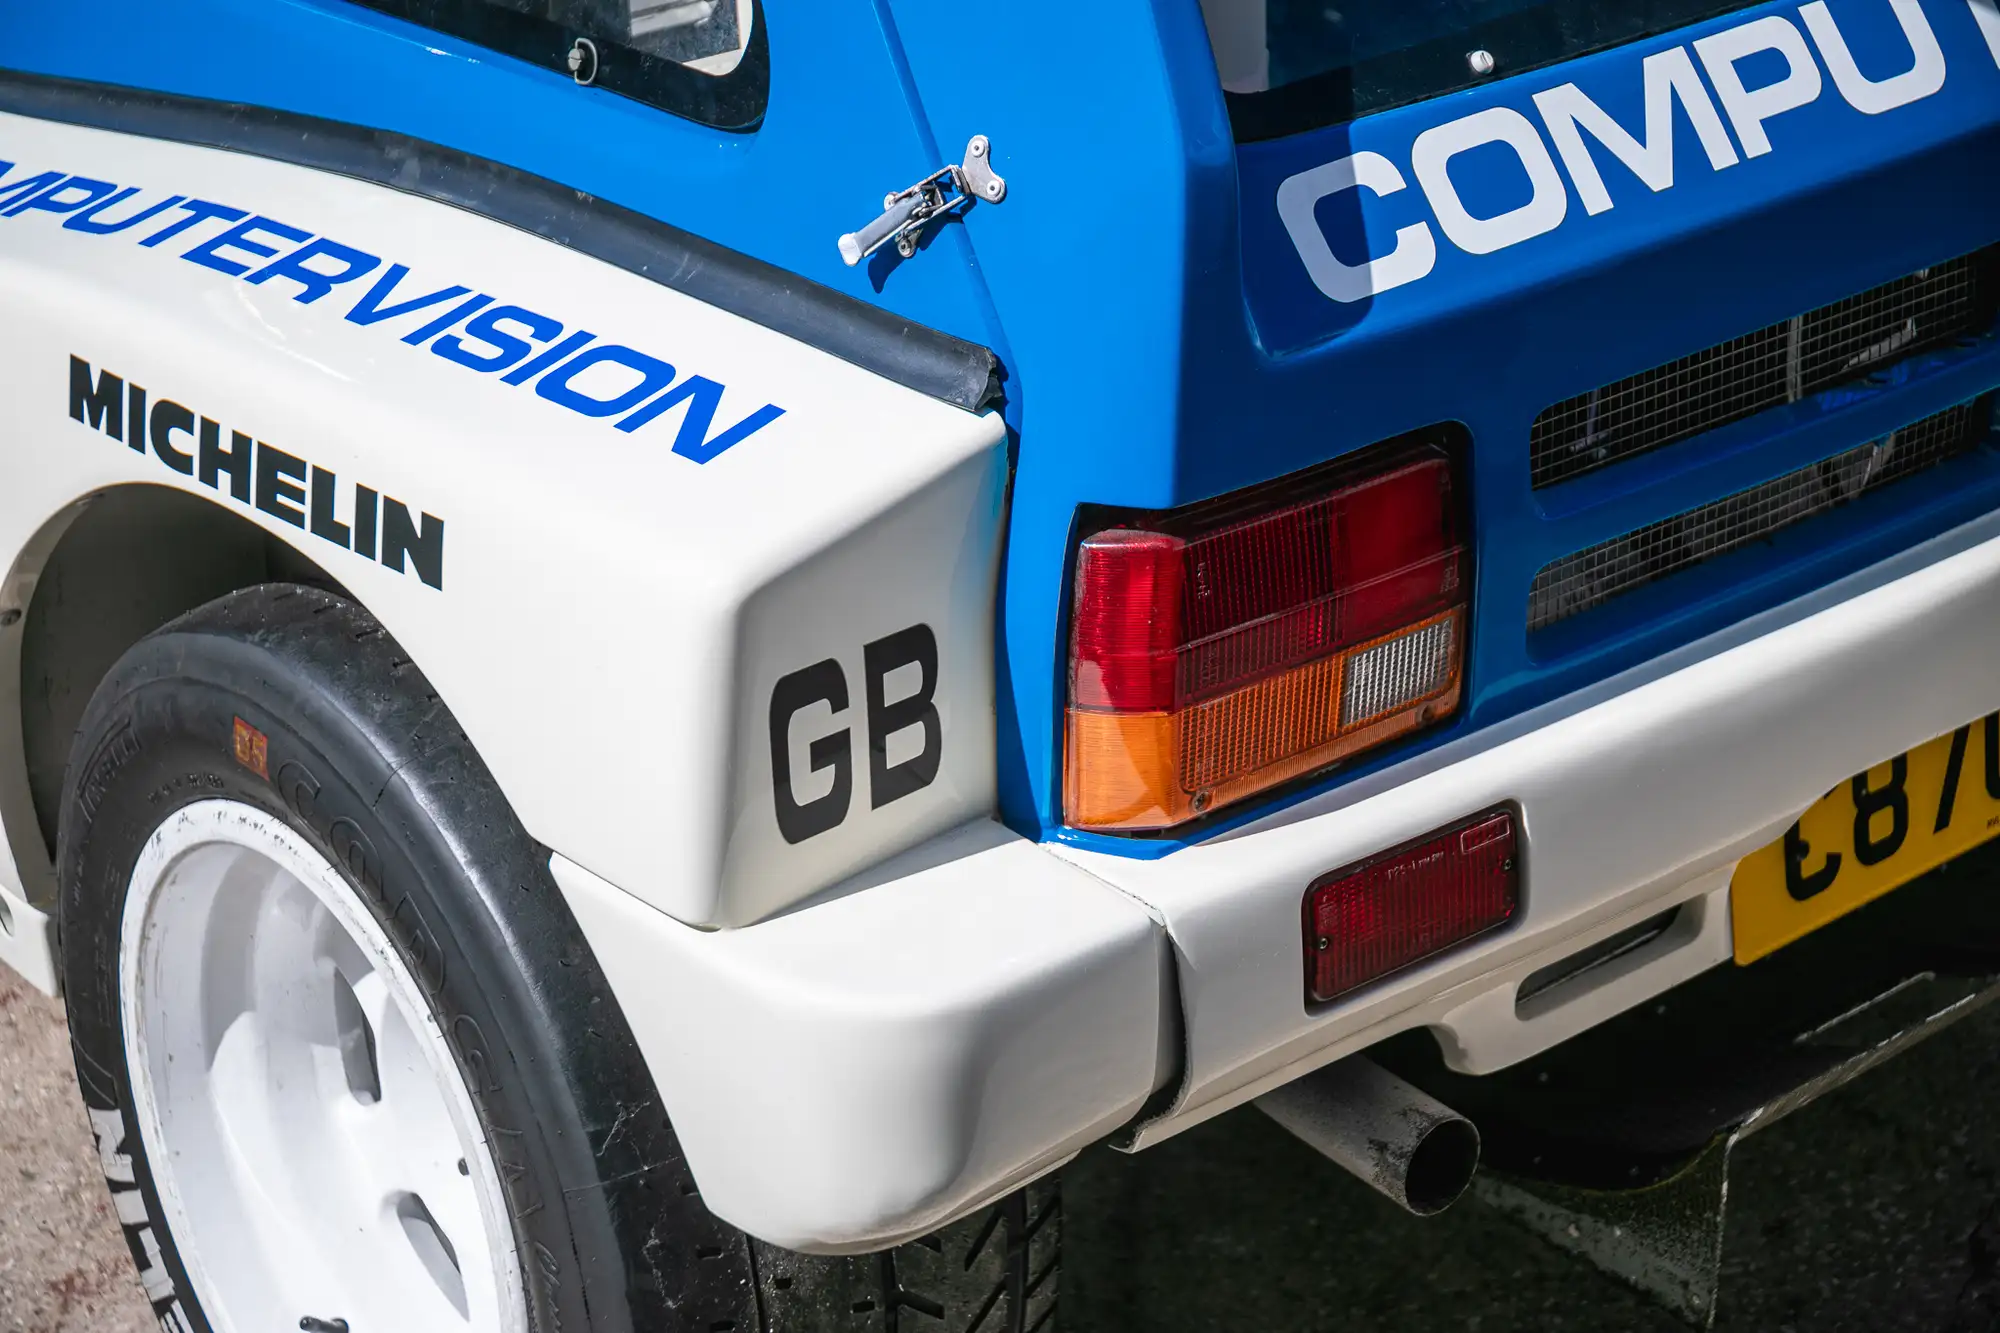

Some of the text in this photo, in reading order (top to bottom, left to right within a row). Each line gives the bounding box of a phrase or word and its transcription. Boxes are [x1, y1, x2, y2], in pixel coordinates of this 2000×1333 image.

[1276, 0, 2000, 303] COMPU
[69, 353, 445, 592] MICHELIN
[769, 622, 942, 845] GB
[1784, 712, 2000, 901] C87
